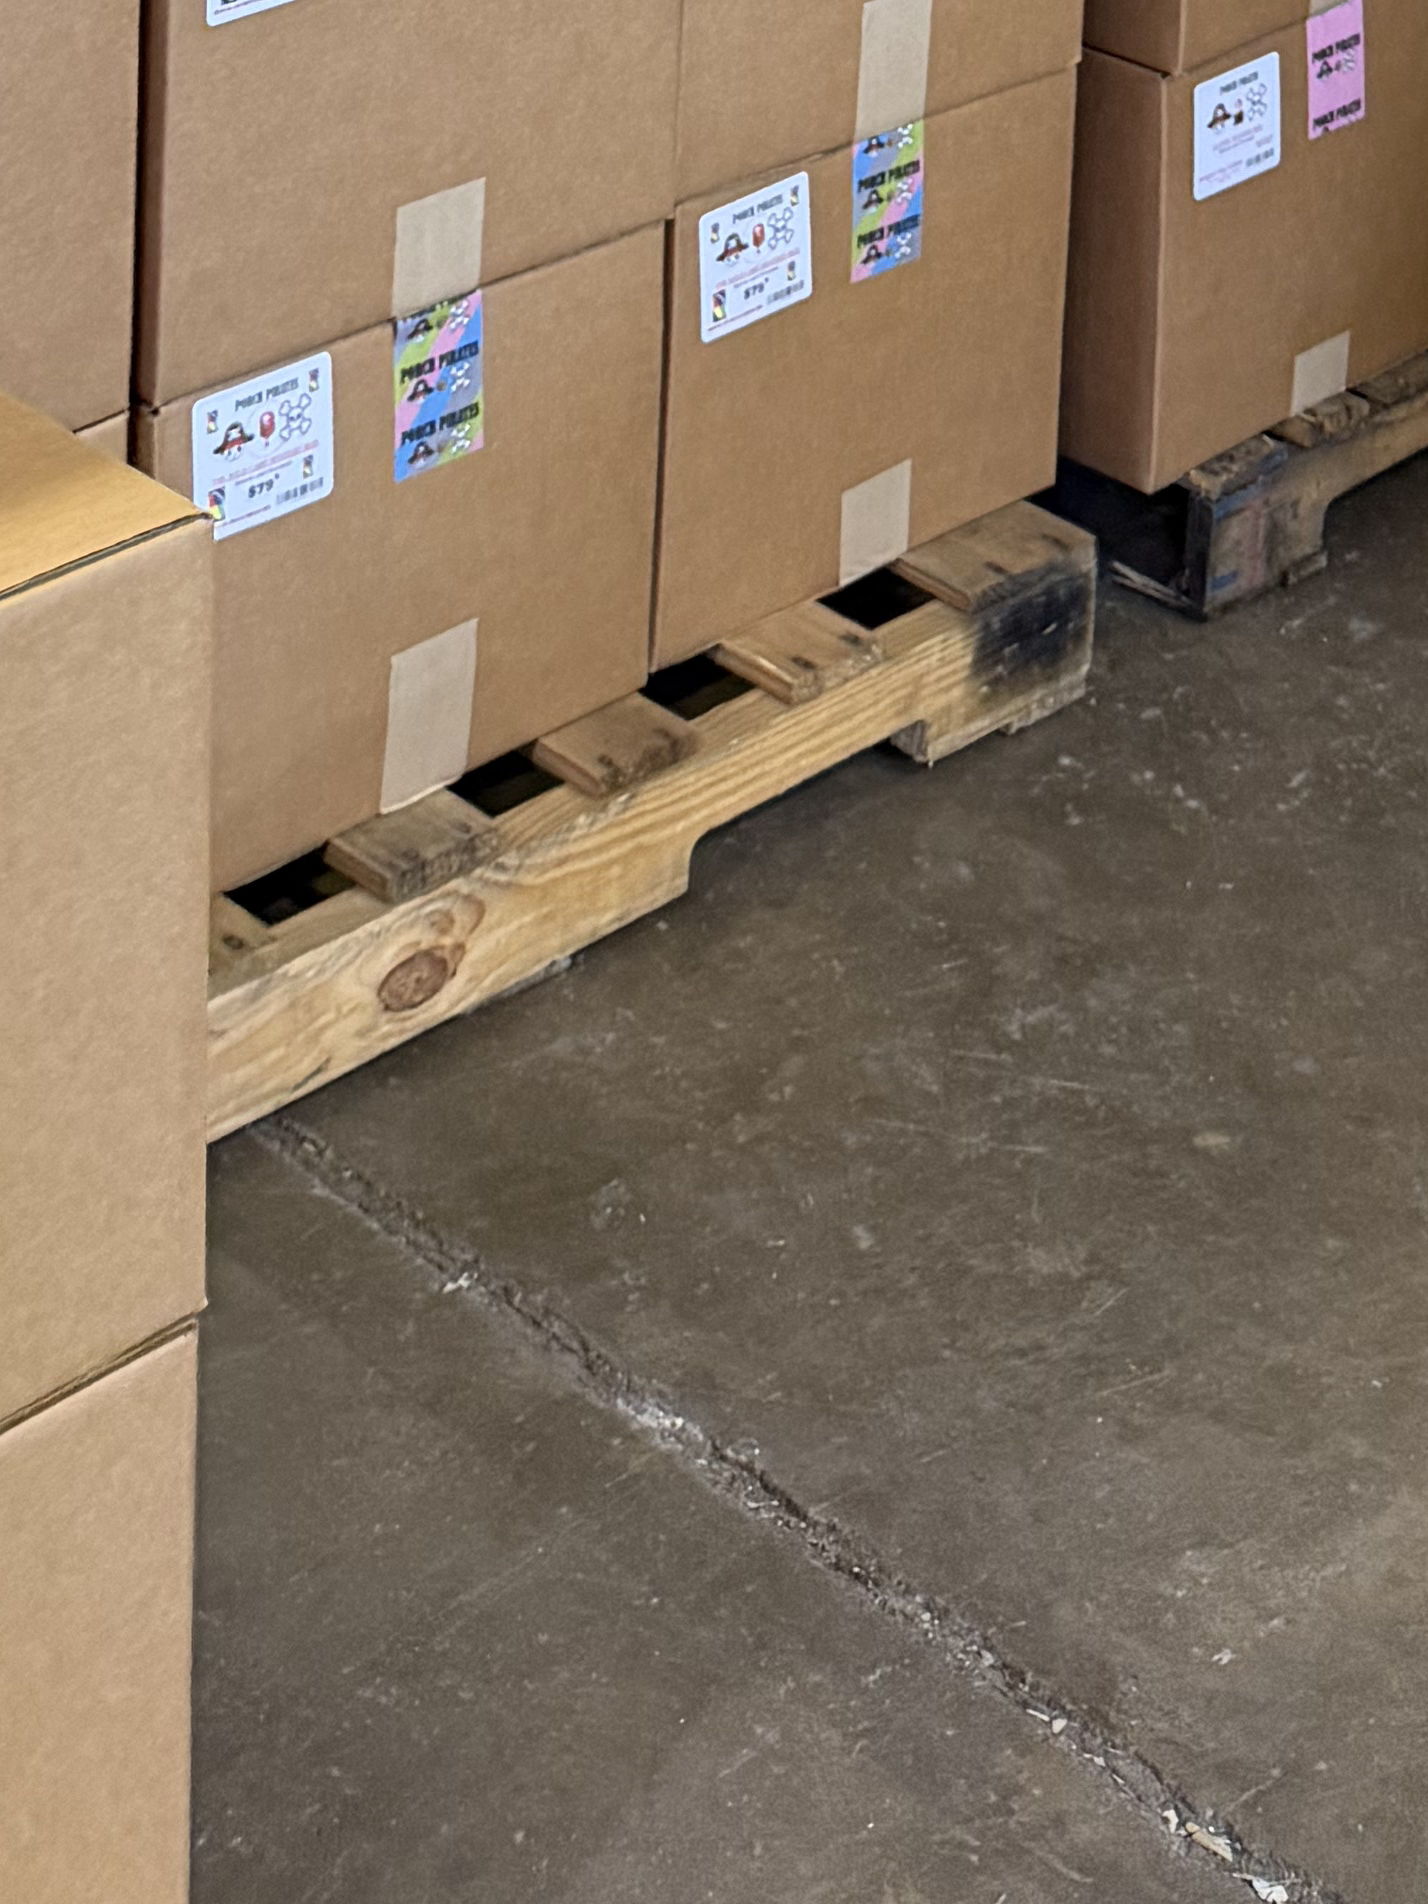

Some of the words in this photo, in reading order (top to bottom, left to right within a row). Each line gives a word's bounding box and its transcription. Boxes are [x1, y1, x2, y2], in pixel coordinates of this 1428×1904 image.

[400, 358, 435, 384] PORCH
[438, 340, 479, 369] PIRATES
[401, 420, 436, 446] PORCH
[439, 403, 479, 431] PIRATES
